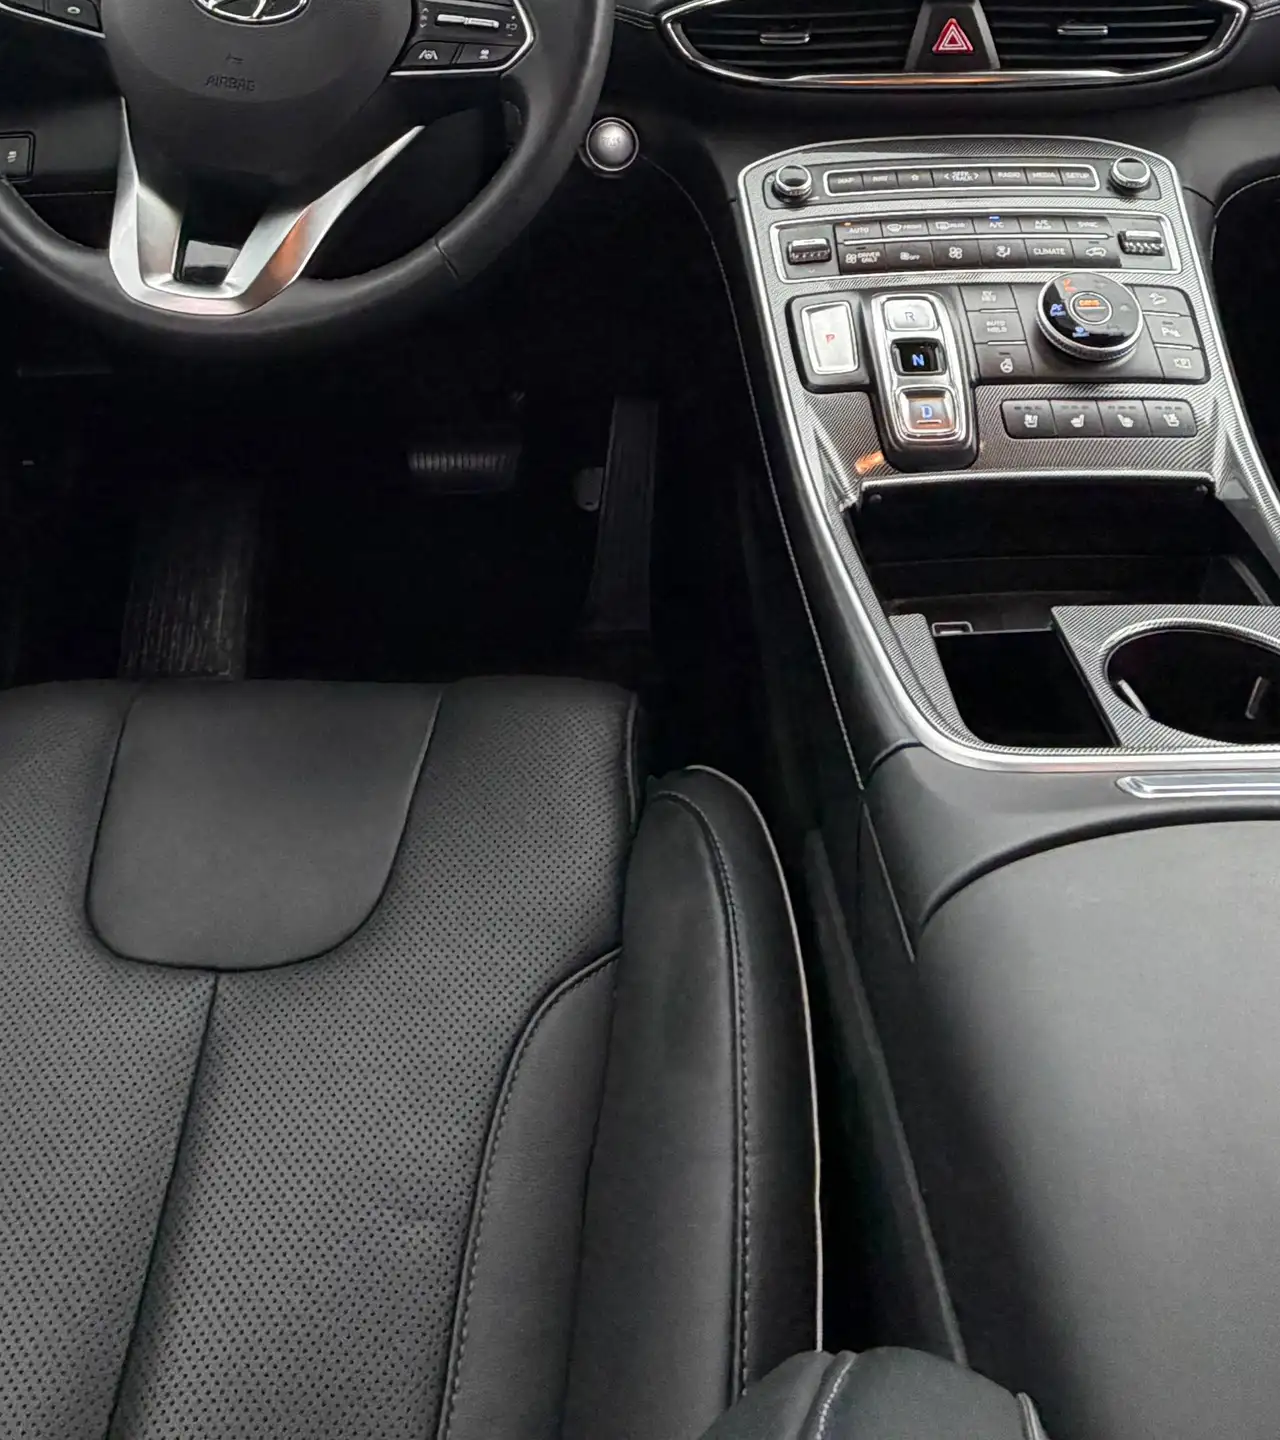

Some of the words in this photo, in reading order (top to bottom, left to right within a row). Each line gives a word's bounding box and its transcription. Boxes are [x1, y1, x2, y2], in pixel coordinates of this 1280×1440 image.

[204, 75, 256, 92] AIRBAG
[1032, 171, 1056, 179] MEDIA
[989, 221, 1005, 229] A/C
[1032, 247, 1066, 255] CLIMATE
[904, 311, 916, 322] R
[825, 334, 835, 345] P
[911, 353, 925, 367] N
[920, 405, 933, 419] D
